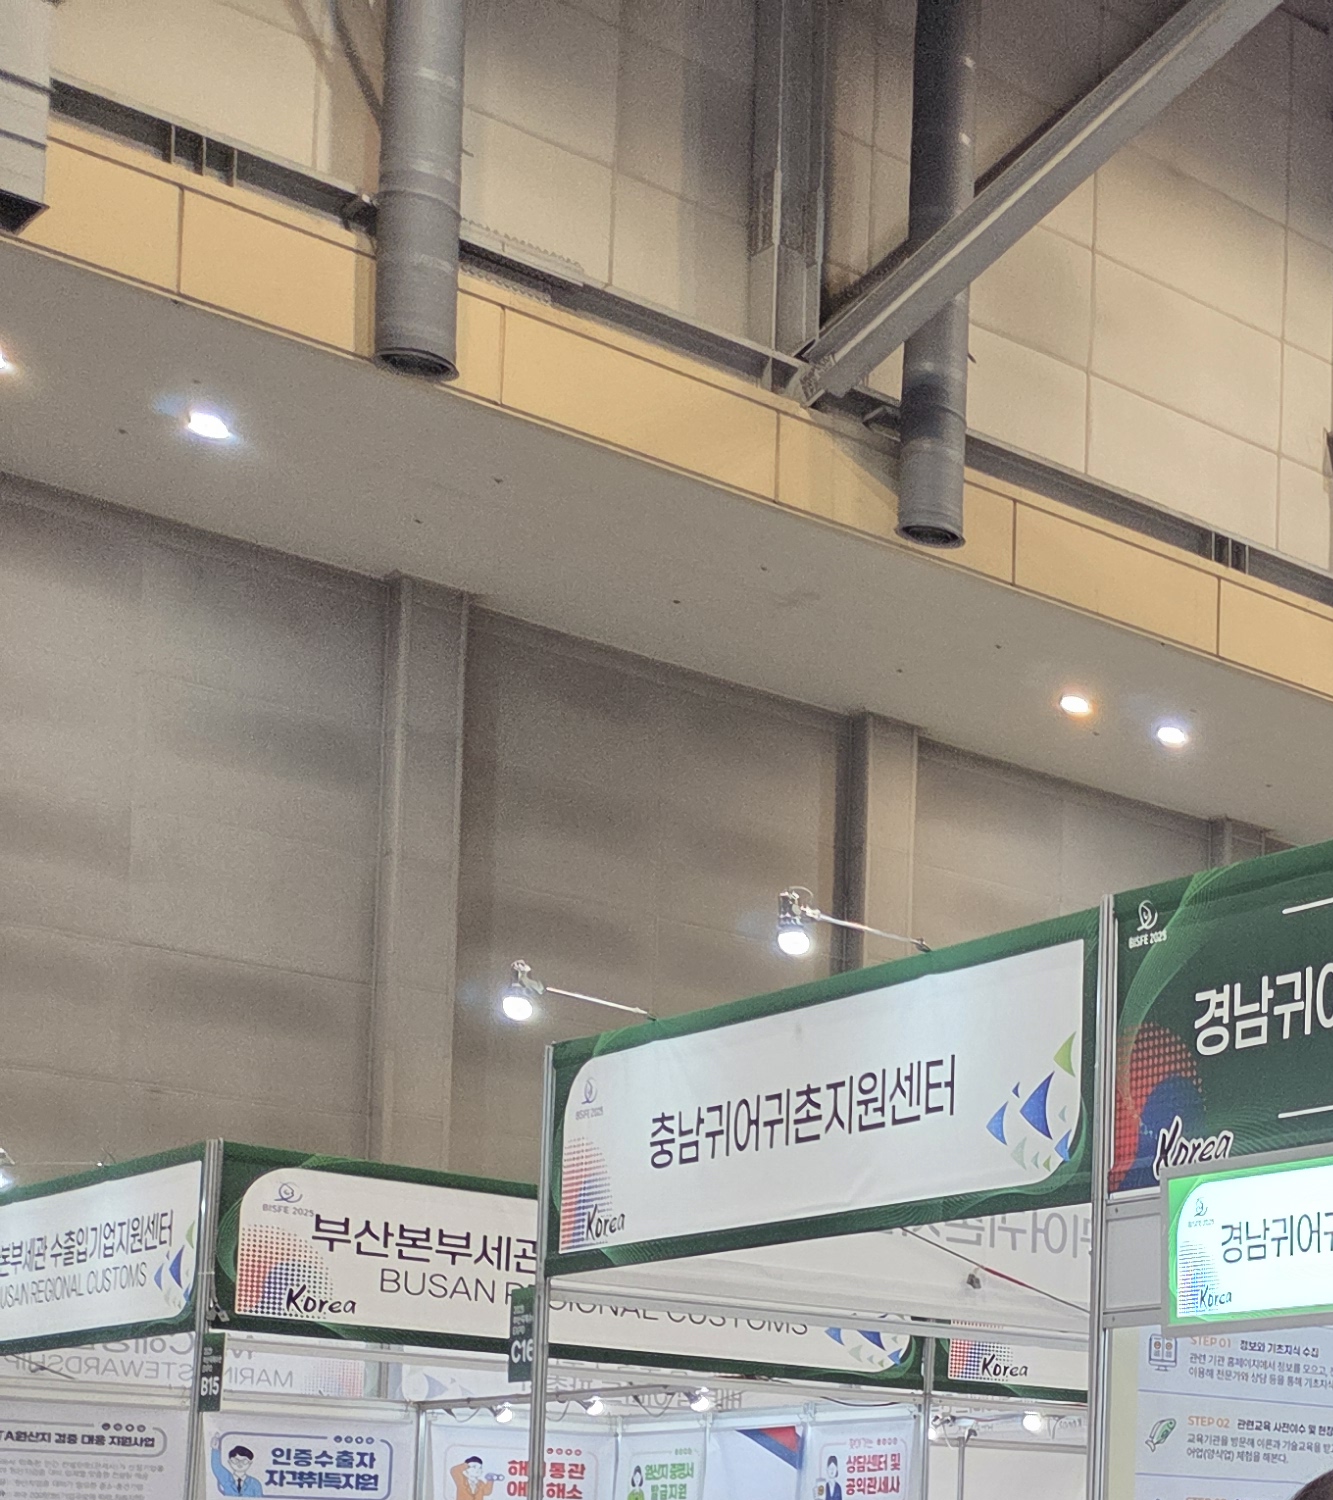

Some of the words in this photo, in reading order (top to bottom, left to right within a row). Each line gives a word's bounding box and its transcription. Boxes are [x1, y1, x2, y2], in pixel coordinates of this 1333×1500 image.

[649, 1055, 956, 1169] 충남귀어귀촌지원센터
[1154, 1116, 1233, 1179] Korea
[586, 1204, 625, 1241] Korea
[50, 1210, 174, 1267] 수출입기업지원센터
[29, 1273, 84, 1305] REGIONAL
[87, 1262, 147, 1294] CUSTOMS
[380, 1268, 495, 1304] BUSAN
[286, 1284, 357, 1314] Korea
[982, 1354, 1028, 1378] Korea
[201, 1376, 219, 1396] B15
[1188, 1415, 1214, 1427] STEP
[1216, 1417, 1230, 1428] 02
[271, 1447, 376, 1469] 인증수출자
[846, 1454, 888, 1473] 상담센터
[890, 1453, 901, 1471] 및
[265, 1470, 379, 1491] 자격취득지원
[549, 1462, 586, 1480] 통관
[546, 1482, 583, 1500] 해소
